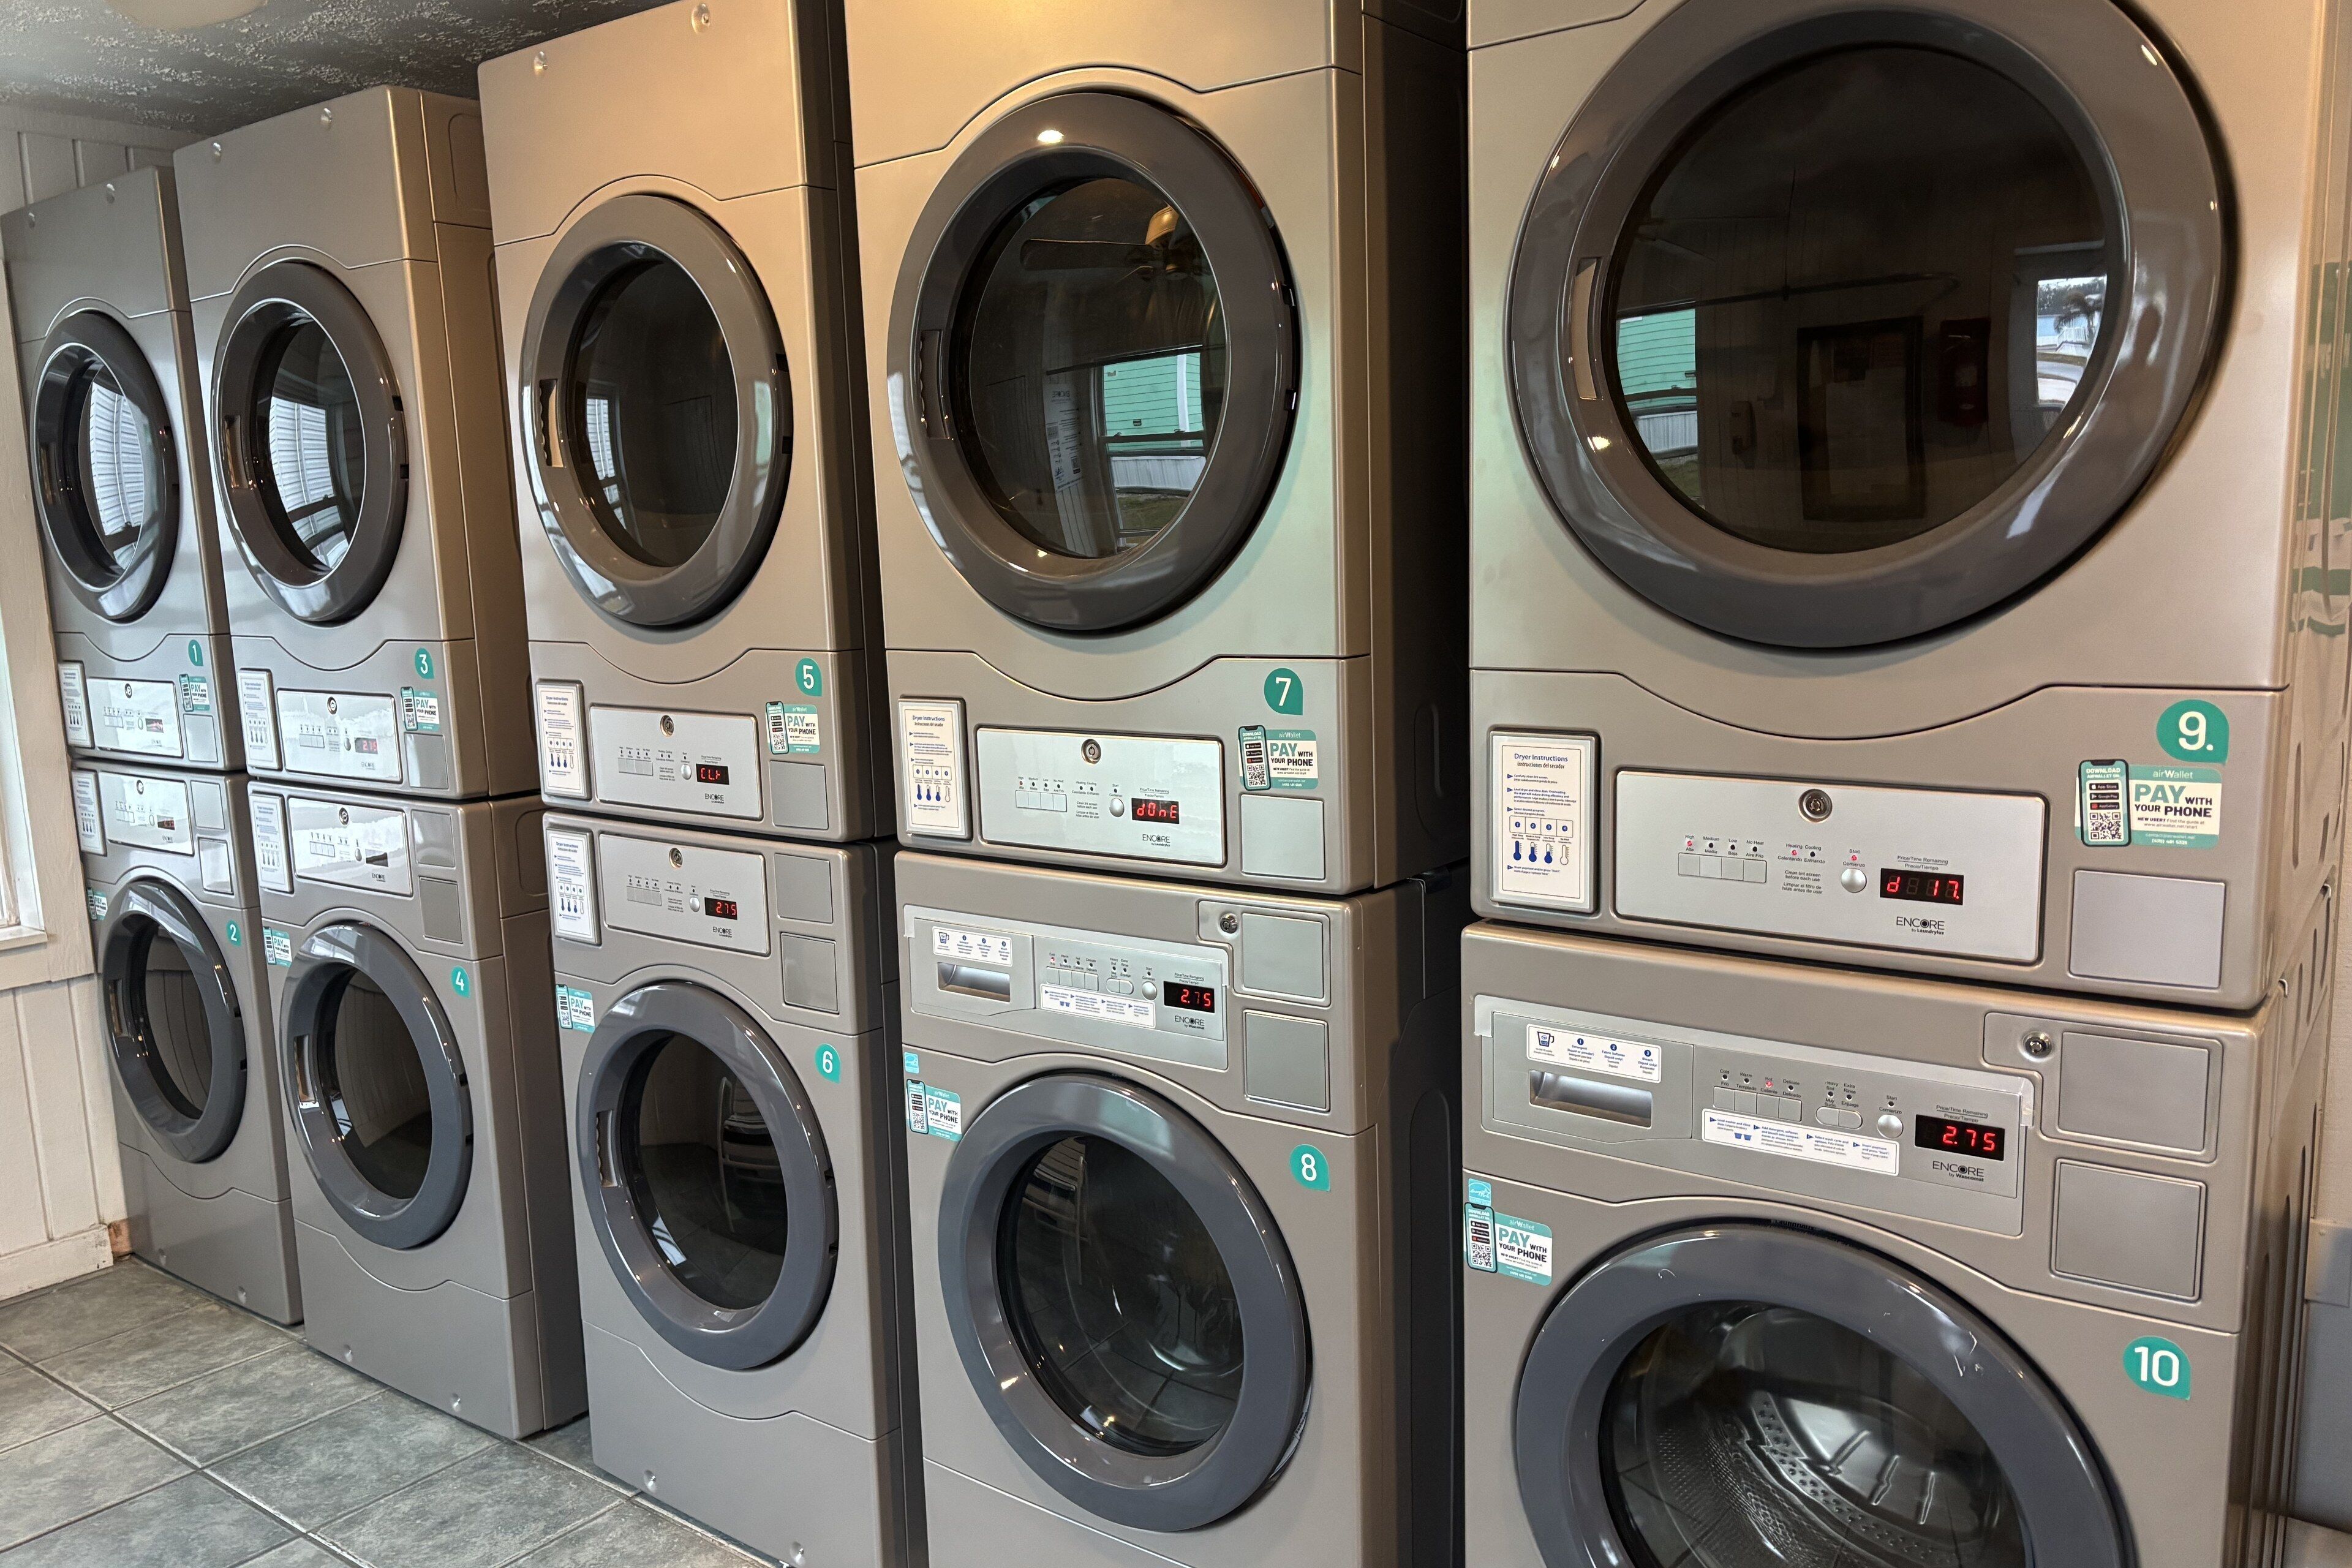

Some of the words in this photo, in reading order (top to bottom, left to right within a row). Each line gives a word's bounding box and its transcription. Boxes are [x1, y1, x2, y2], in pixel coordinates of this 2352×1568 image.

[192, 644, 197, 662] 1
[420, 654, 428, 674] 3
[803, 665, 814, 689] 5
[1276, 677, 1291, 706] 7
[416, 699, 429, 708] PAY
[787, 715, 805, 726] PAY
[1270, 743, 1298, 757] PAY
[2153, 770, 2193, 779] airWallet
[2134, 783, 2186, 804] PAY
[2185, 797, 2212, 805] WITH
[2165, 806, 2212, 818] PHONE
[1142, 834, 1170, 843] ENCORE
[1896, 916, 1945, 930] ENCORE
[230, 924, 237, 941] 2
[456, 971, 464, 990] 4
[571, 998, 583, 1009] PAY
[1181, 989, 1210, 1006] 2.75
[1175, 1016, 1205, 1026] ENCORE
[823, 1051, 832, 1073] 6
[929, 1098, 947, 1112] PAY
[940, 1114, 958, 1123] PHONE
[1943, 1126, 1995, 1151] 2.75
[1302, 1153, 1317, 1181] 8
[1933, 1161, 1984, 1177] ENCORE
[1509, 1219, 1534, 1231] airWallet
[1499, 1227, 1530, 1248] PAY
[1530, 1243, 1547, 1253] WITH
[1499, 1243, 1515, 1252] YOUR
[1518, 1248, 1547, 1262] PHONE
[2135, 1346, 2179, 1386] 10
